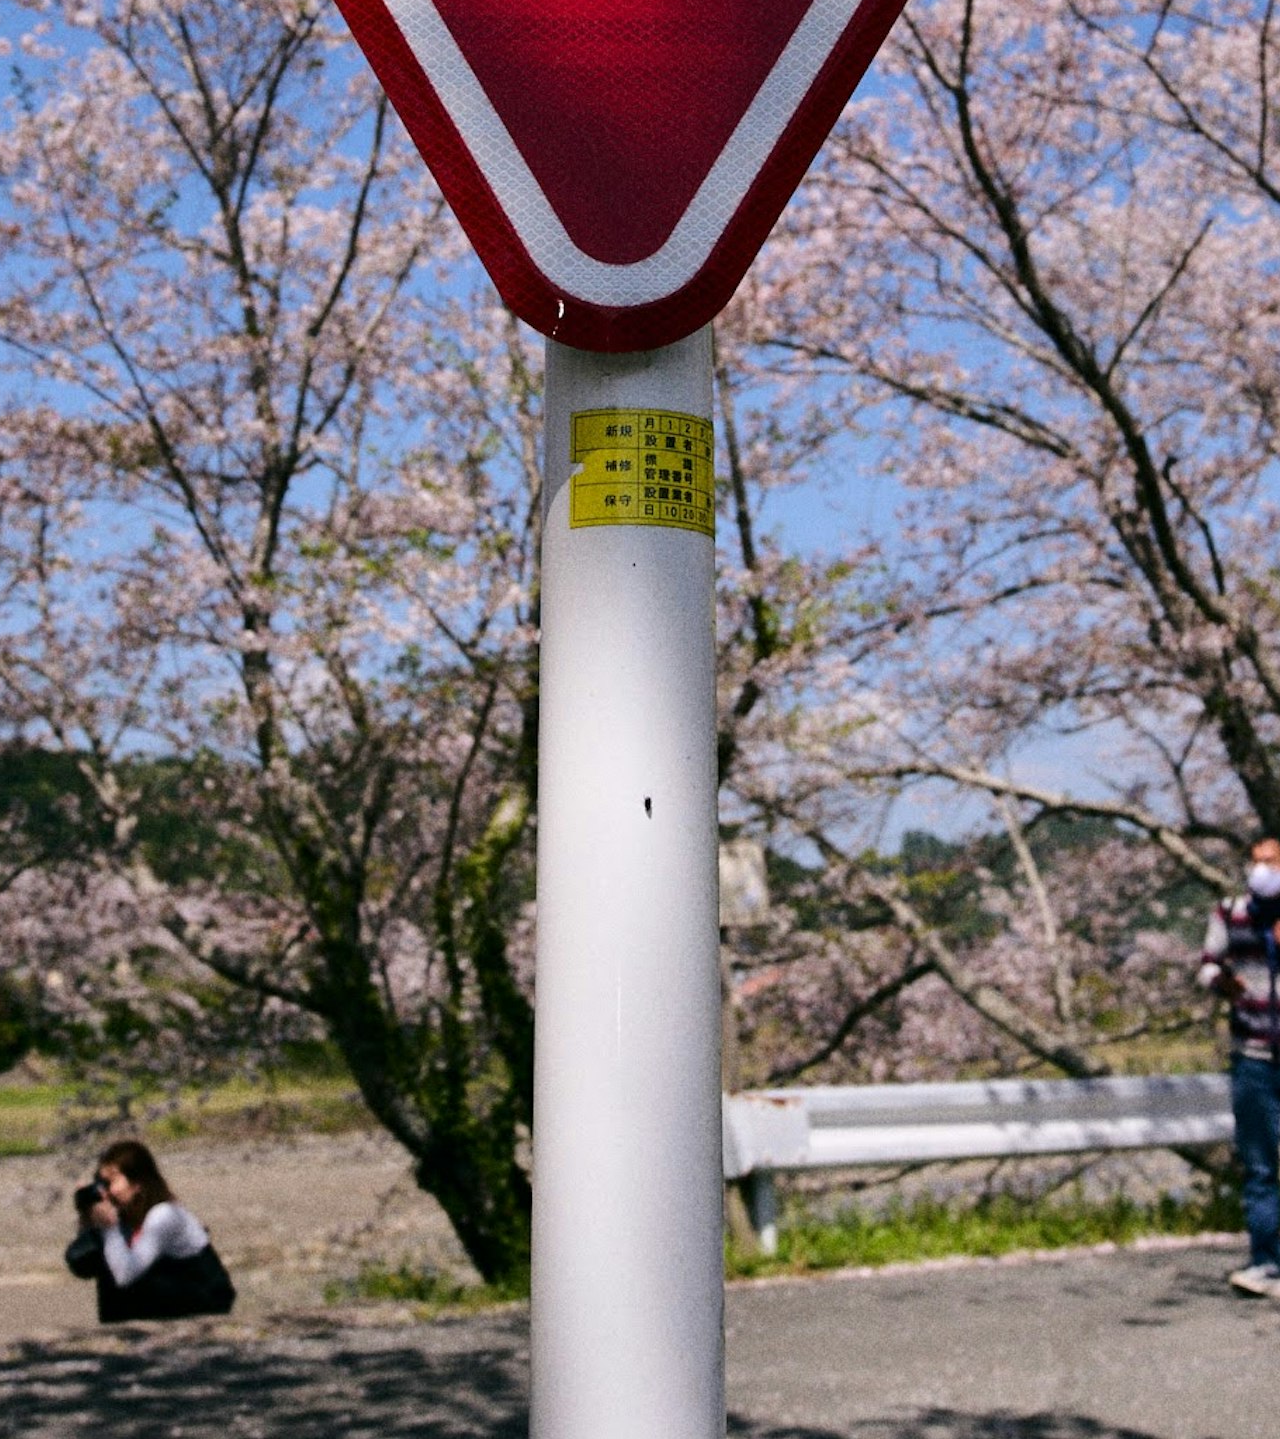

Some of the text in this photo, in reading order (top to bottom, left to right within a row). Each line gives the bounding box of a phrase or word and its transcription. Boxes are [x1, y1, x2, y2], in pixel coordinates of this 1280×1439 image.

[605, 425, 632, 438] 新規
[645, 417, 654, 429] 月
[685, 423, 691, 433] 2
[605, 460, 632, 472] 補修
[644, 467, 693, 485] 管理番号
[604, 494, 632, 507] 保守
[644, 504, 654, 515] 日
[665, 506, 677, 517] 10
[683, 508, 694, 520] 20
